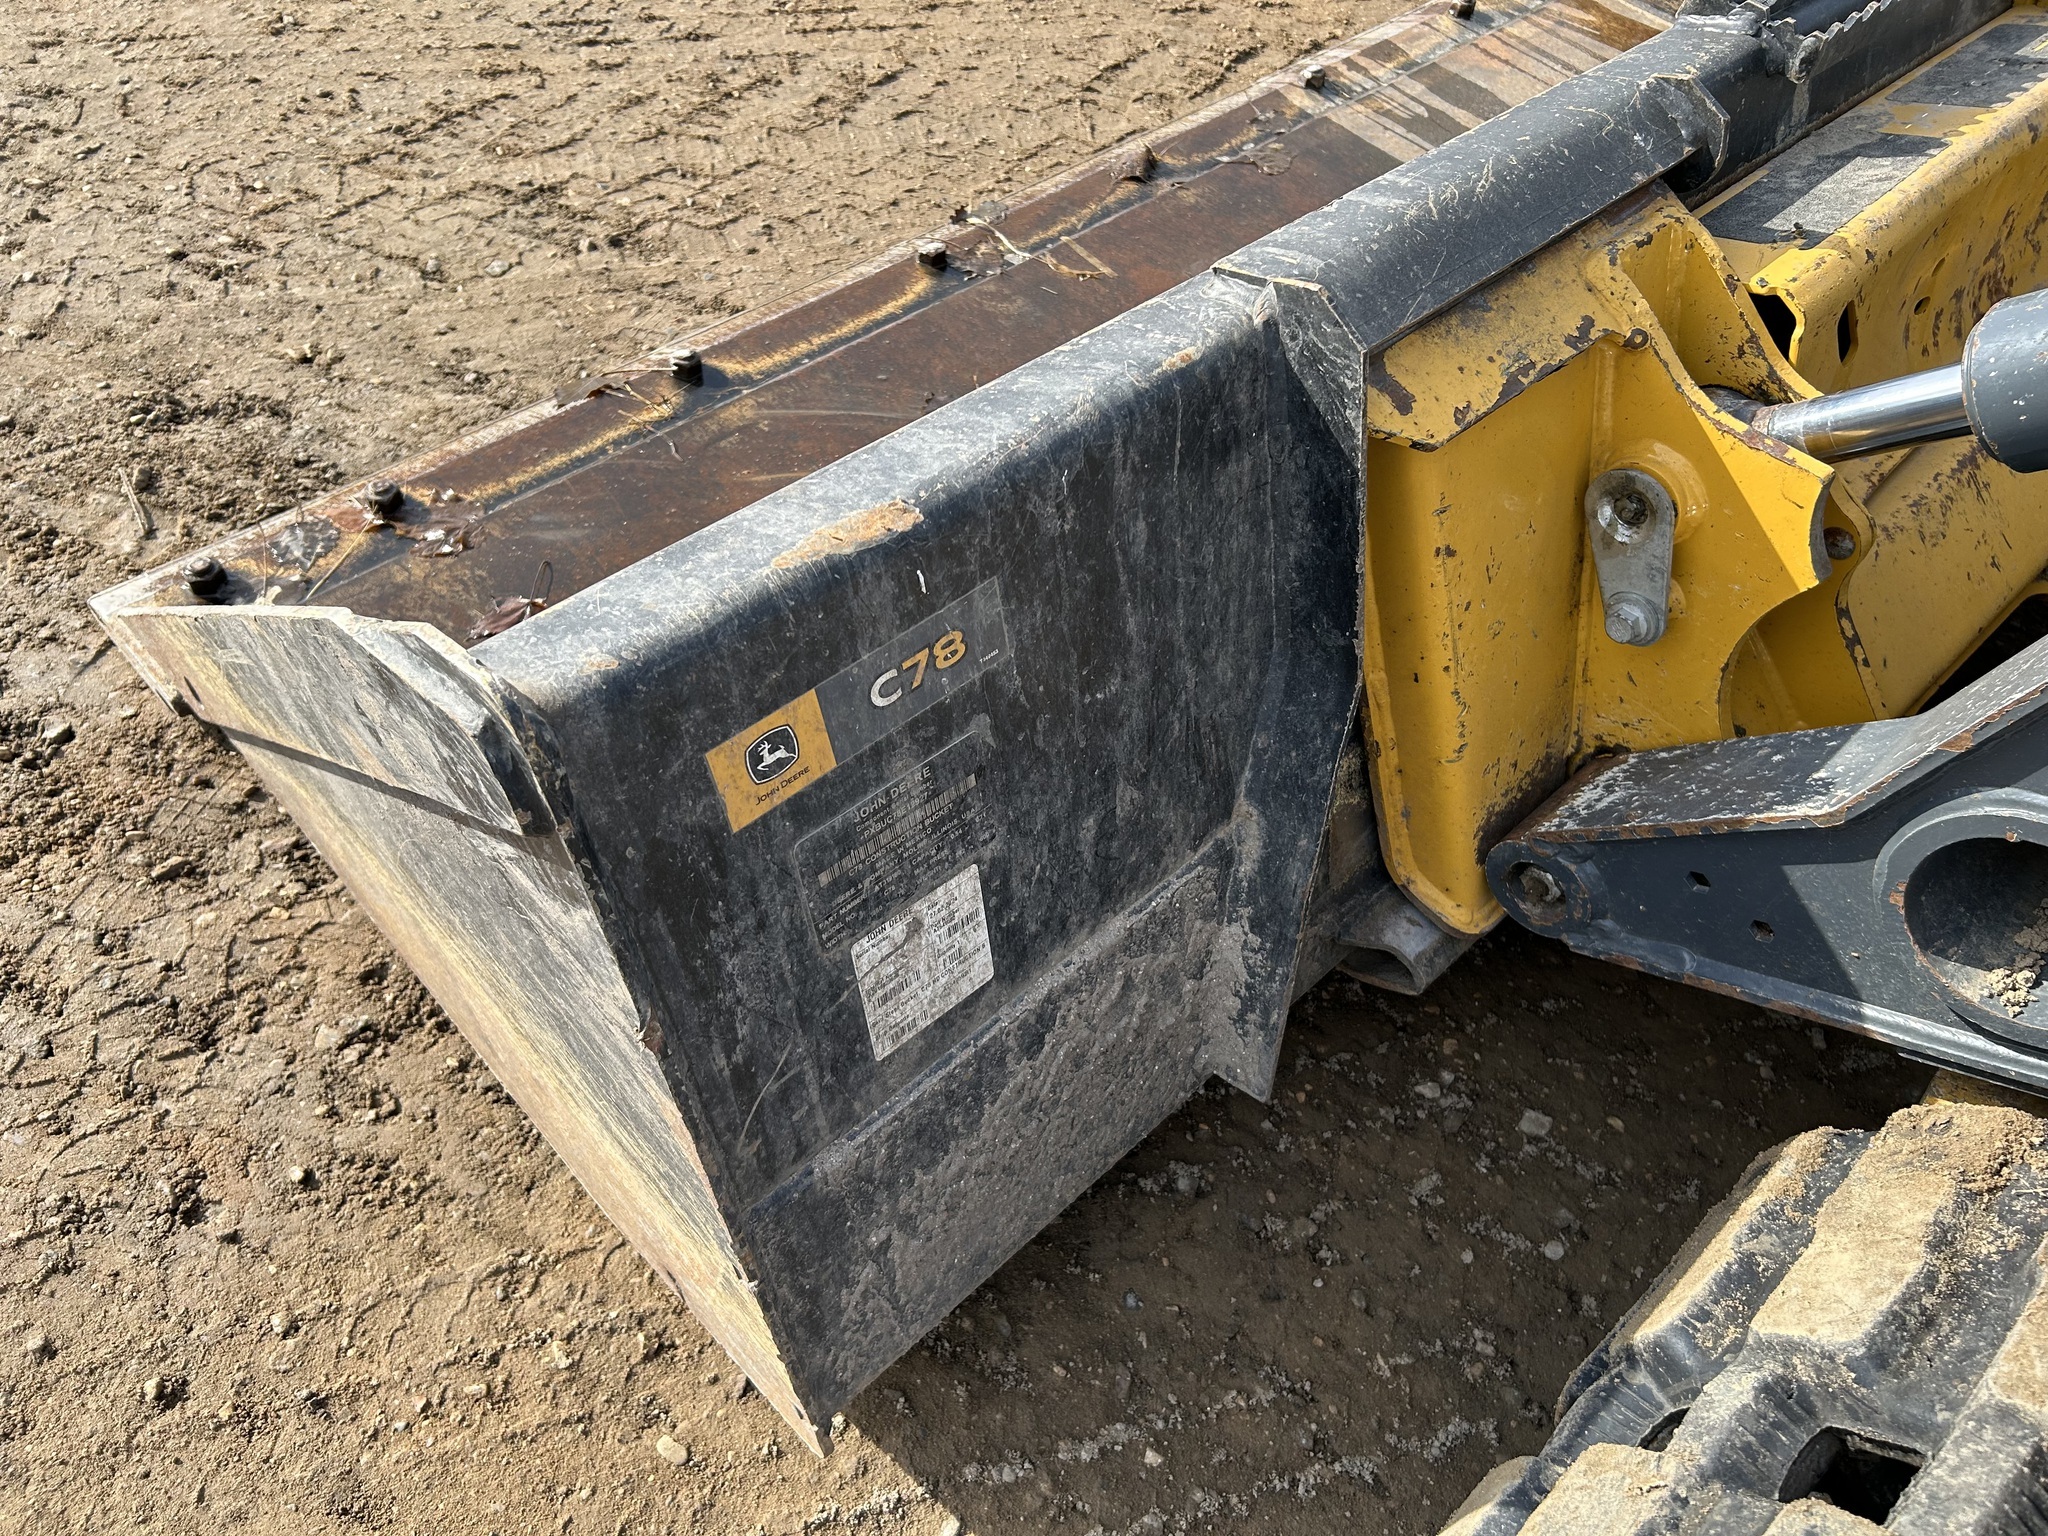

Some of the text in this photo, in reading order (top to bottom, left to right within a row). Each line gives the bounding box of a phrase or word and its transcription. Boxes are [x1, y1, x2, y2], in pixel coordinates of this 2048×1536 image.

[870, 629, 967, 708] C78
[753, 763, 811, 807] JOHN DEERE
[852, 765, 931, 823] JOHN DEERE
[848, 802, 953, 877] C78 CONSTRUCTION BUCKET
[905, 826, 932, 848] MEXICO
[865, 923, 886, 944] JOHN
[888, 905, 913, 927] DEERE
